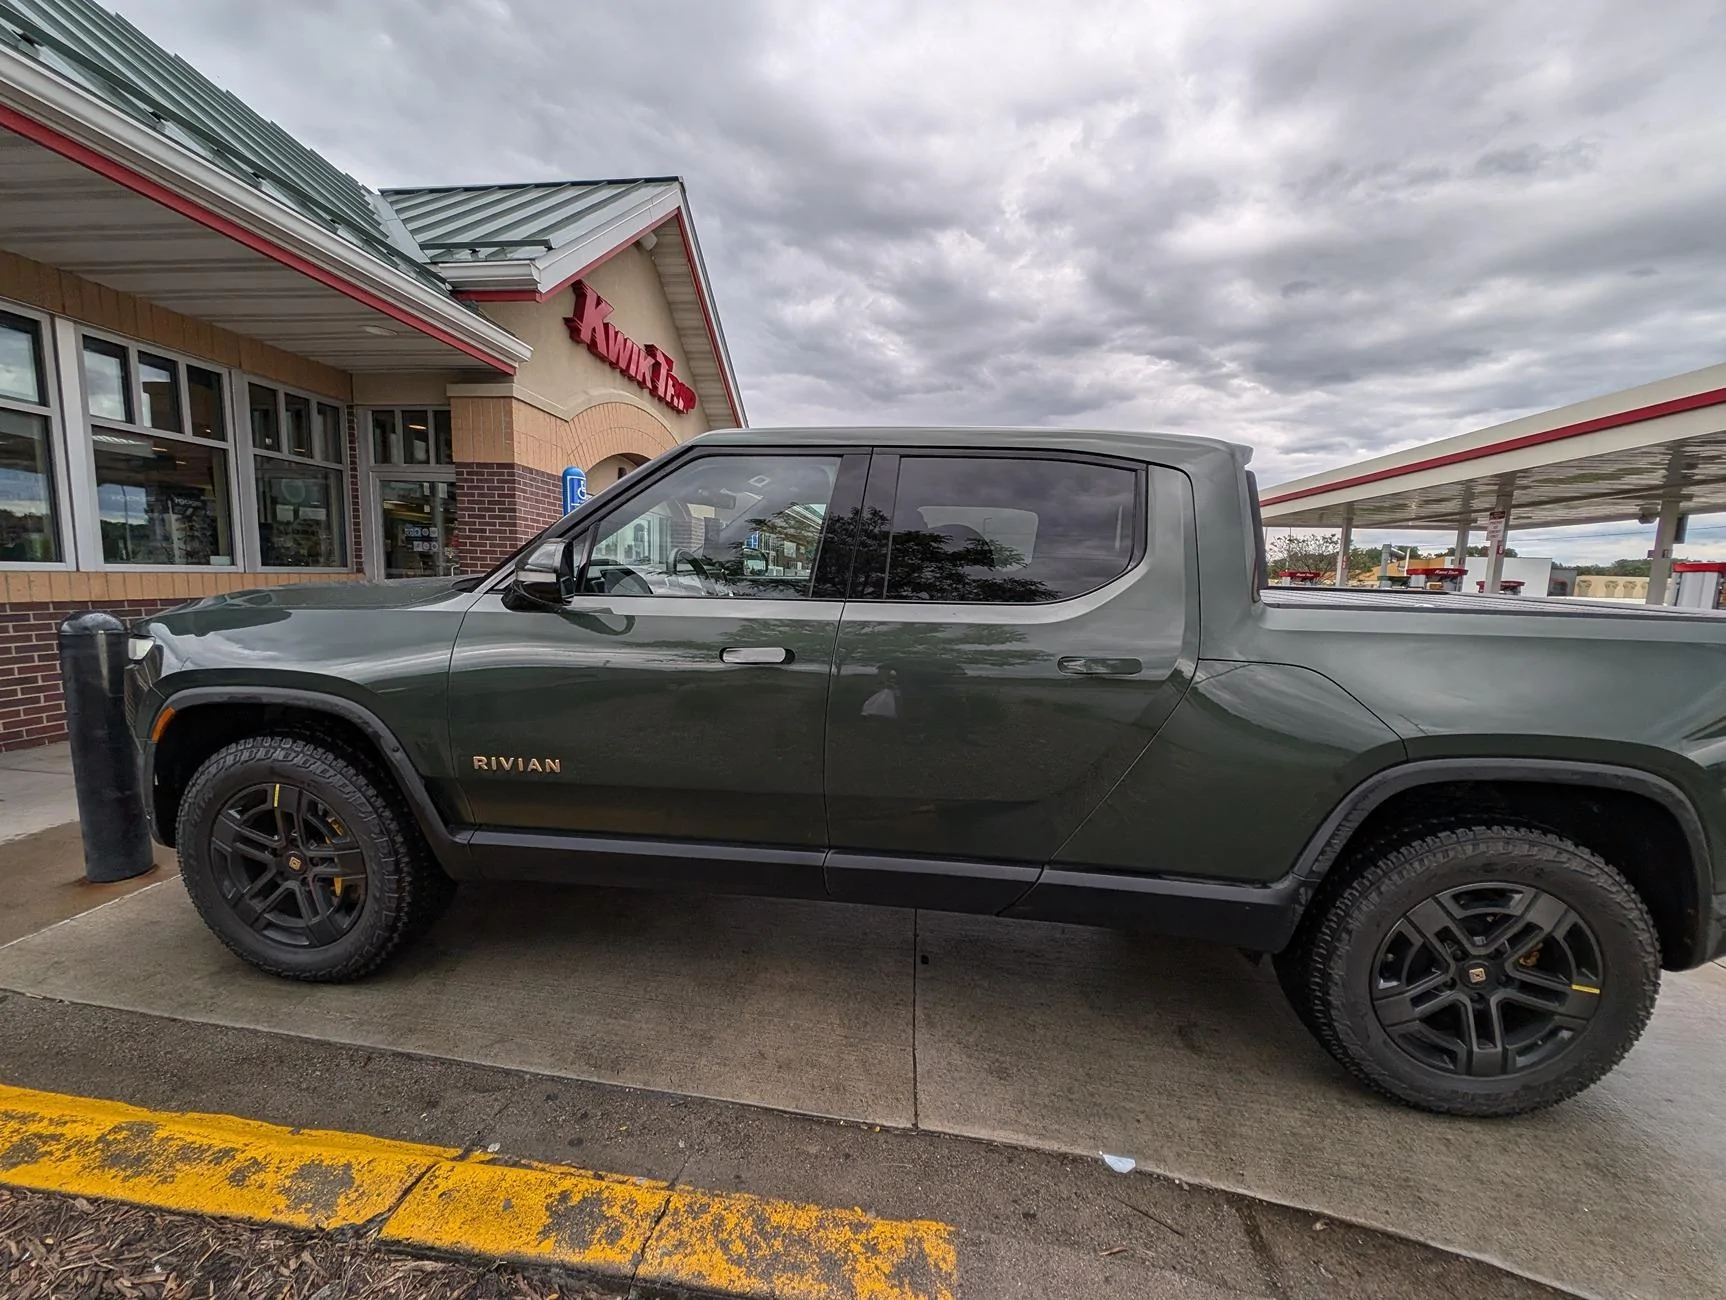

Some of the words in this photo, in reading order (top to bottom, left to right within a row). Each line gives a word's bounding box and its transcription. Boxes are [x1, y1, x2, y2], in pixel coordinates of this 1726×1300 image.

[564, 279, 656, 390] KWIK
[645, 344, 698, 415] TR
[472, 755, 562, 774] RIVIAN
